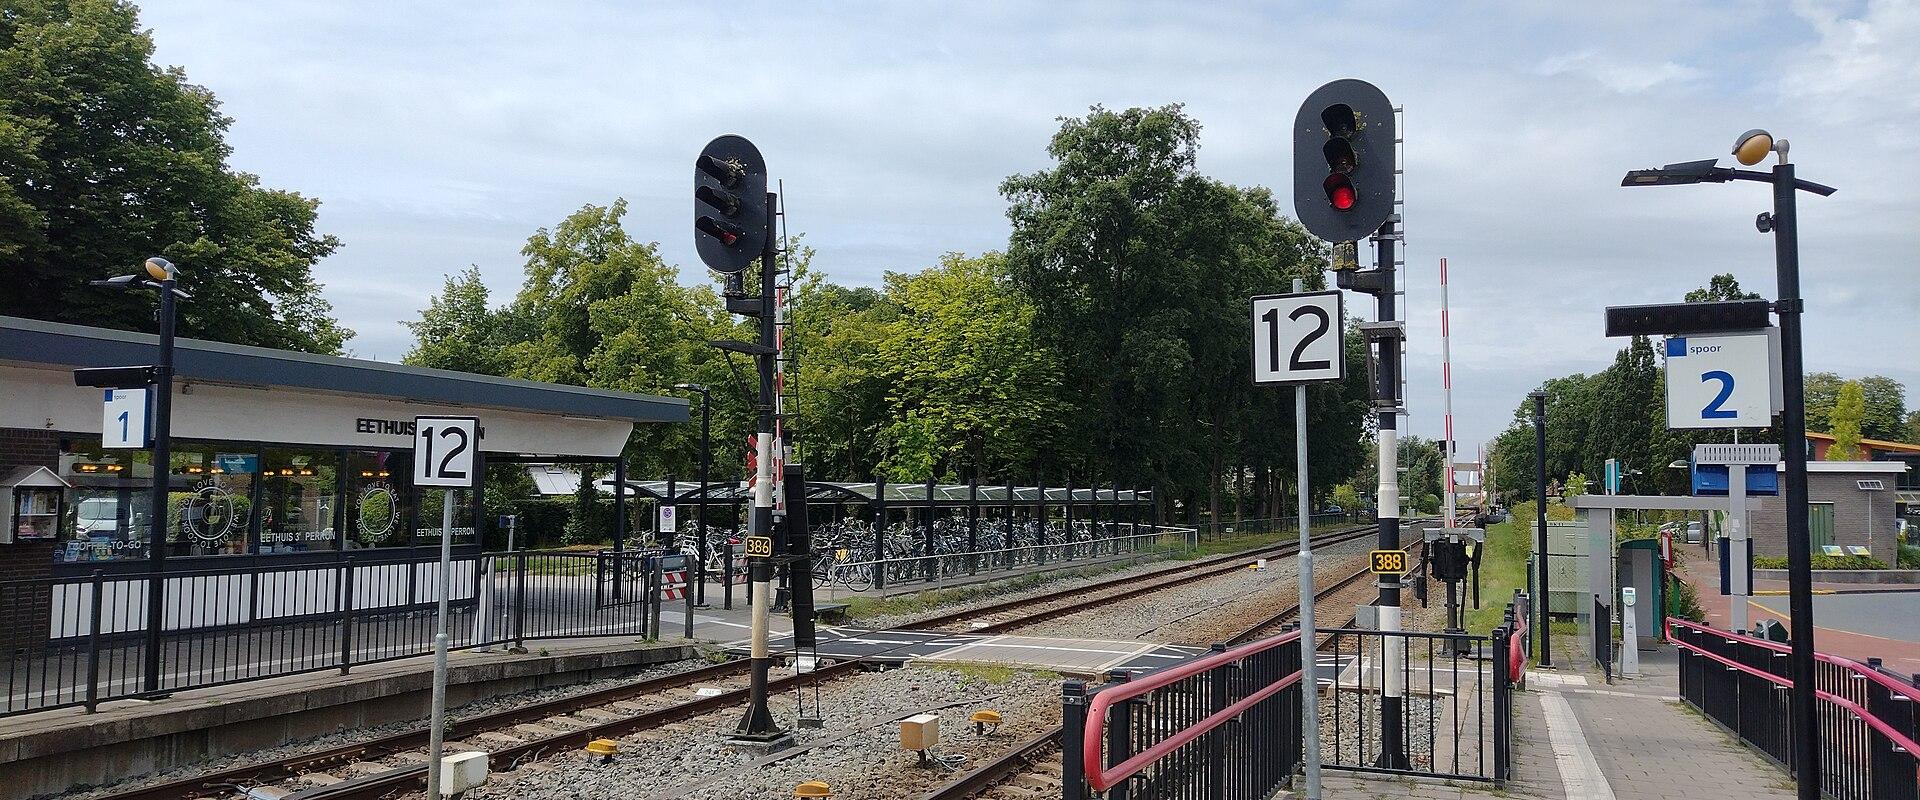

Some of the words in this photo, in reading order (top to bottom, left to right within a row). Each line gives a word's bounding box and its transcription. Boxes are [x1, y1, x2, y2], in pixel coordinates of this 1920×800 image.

[1261, 304, 1331, 372] 12
[1690, 344, 1722, 355] spoor
[1701, 370, 1738, 419] 2
[117, 410, 129, 442] 1
[356, 417, 416, 436] EETHUIS
[421, 426, 468, 479] 12
[193, 478, 213, 492] LOVE
[181, 521, 198, 543] COOK
[260, 531, 294, 543] EETHUIS
[305, 530, 336, 541] PERRON
[416, 527, 443, 537] EETHUIS
[450, 527, 475, 536] PERRON
[747, 539, 769, 554] 386
[1375, 553, 1402, 570] 388
